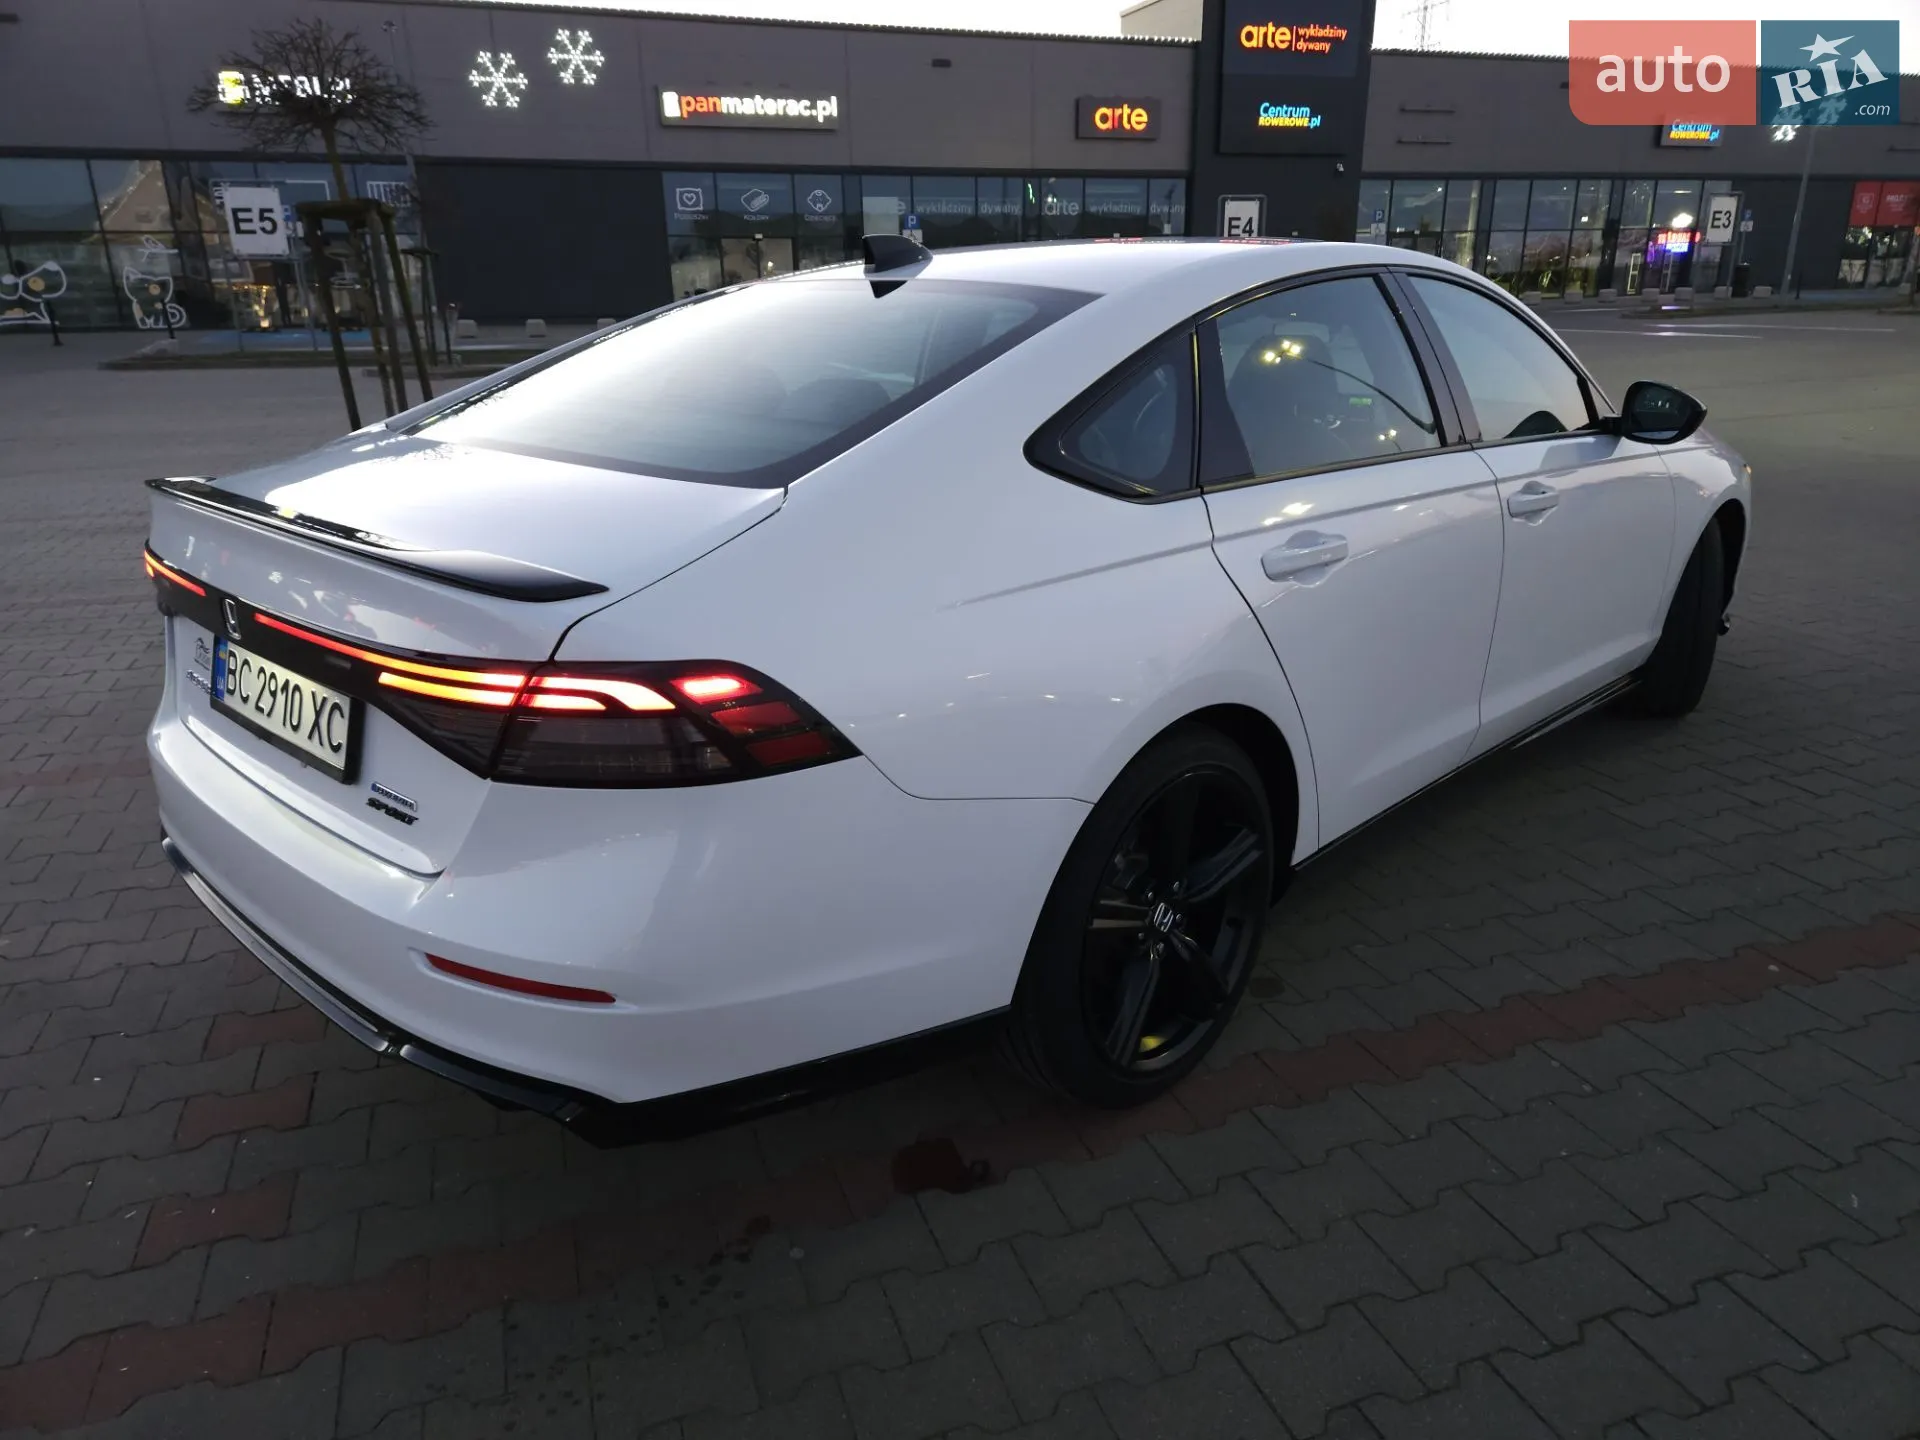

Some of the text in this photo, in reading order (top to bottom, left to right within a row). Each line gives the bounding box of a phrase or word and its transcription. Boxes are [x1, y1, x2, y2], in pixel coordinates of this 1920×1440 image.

[1240, 21, 1292, 49] arte
[1296, 38, 1331, 53] dywany
[680, 94, 838, 123] panmaterac.pl
[1094, 103, 1148, 131] arte
[1260, 102, 1311, 118] Centrum
[1044, 199, 1080, 216] arte
[231, 207, 278, 235] E5
[908, 215, 917, 229] P
[1227, 216, 1255, 237] E4
[1710, 210, 1732, 229] E3
[225, 648, 345, 754] BC 2910 XC
